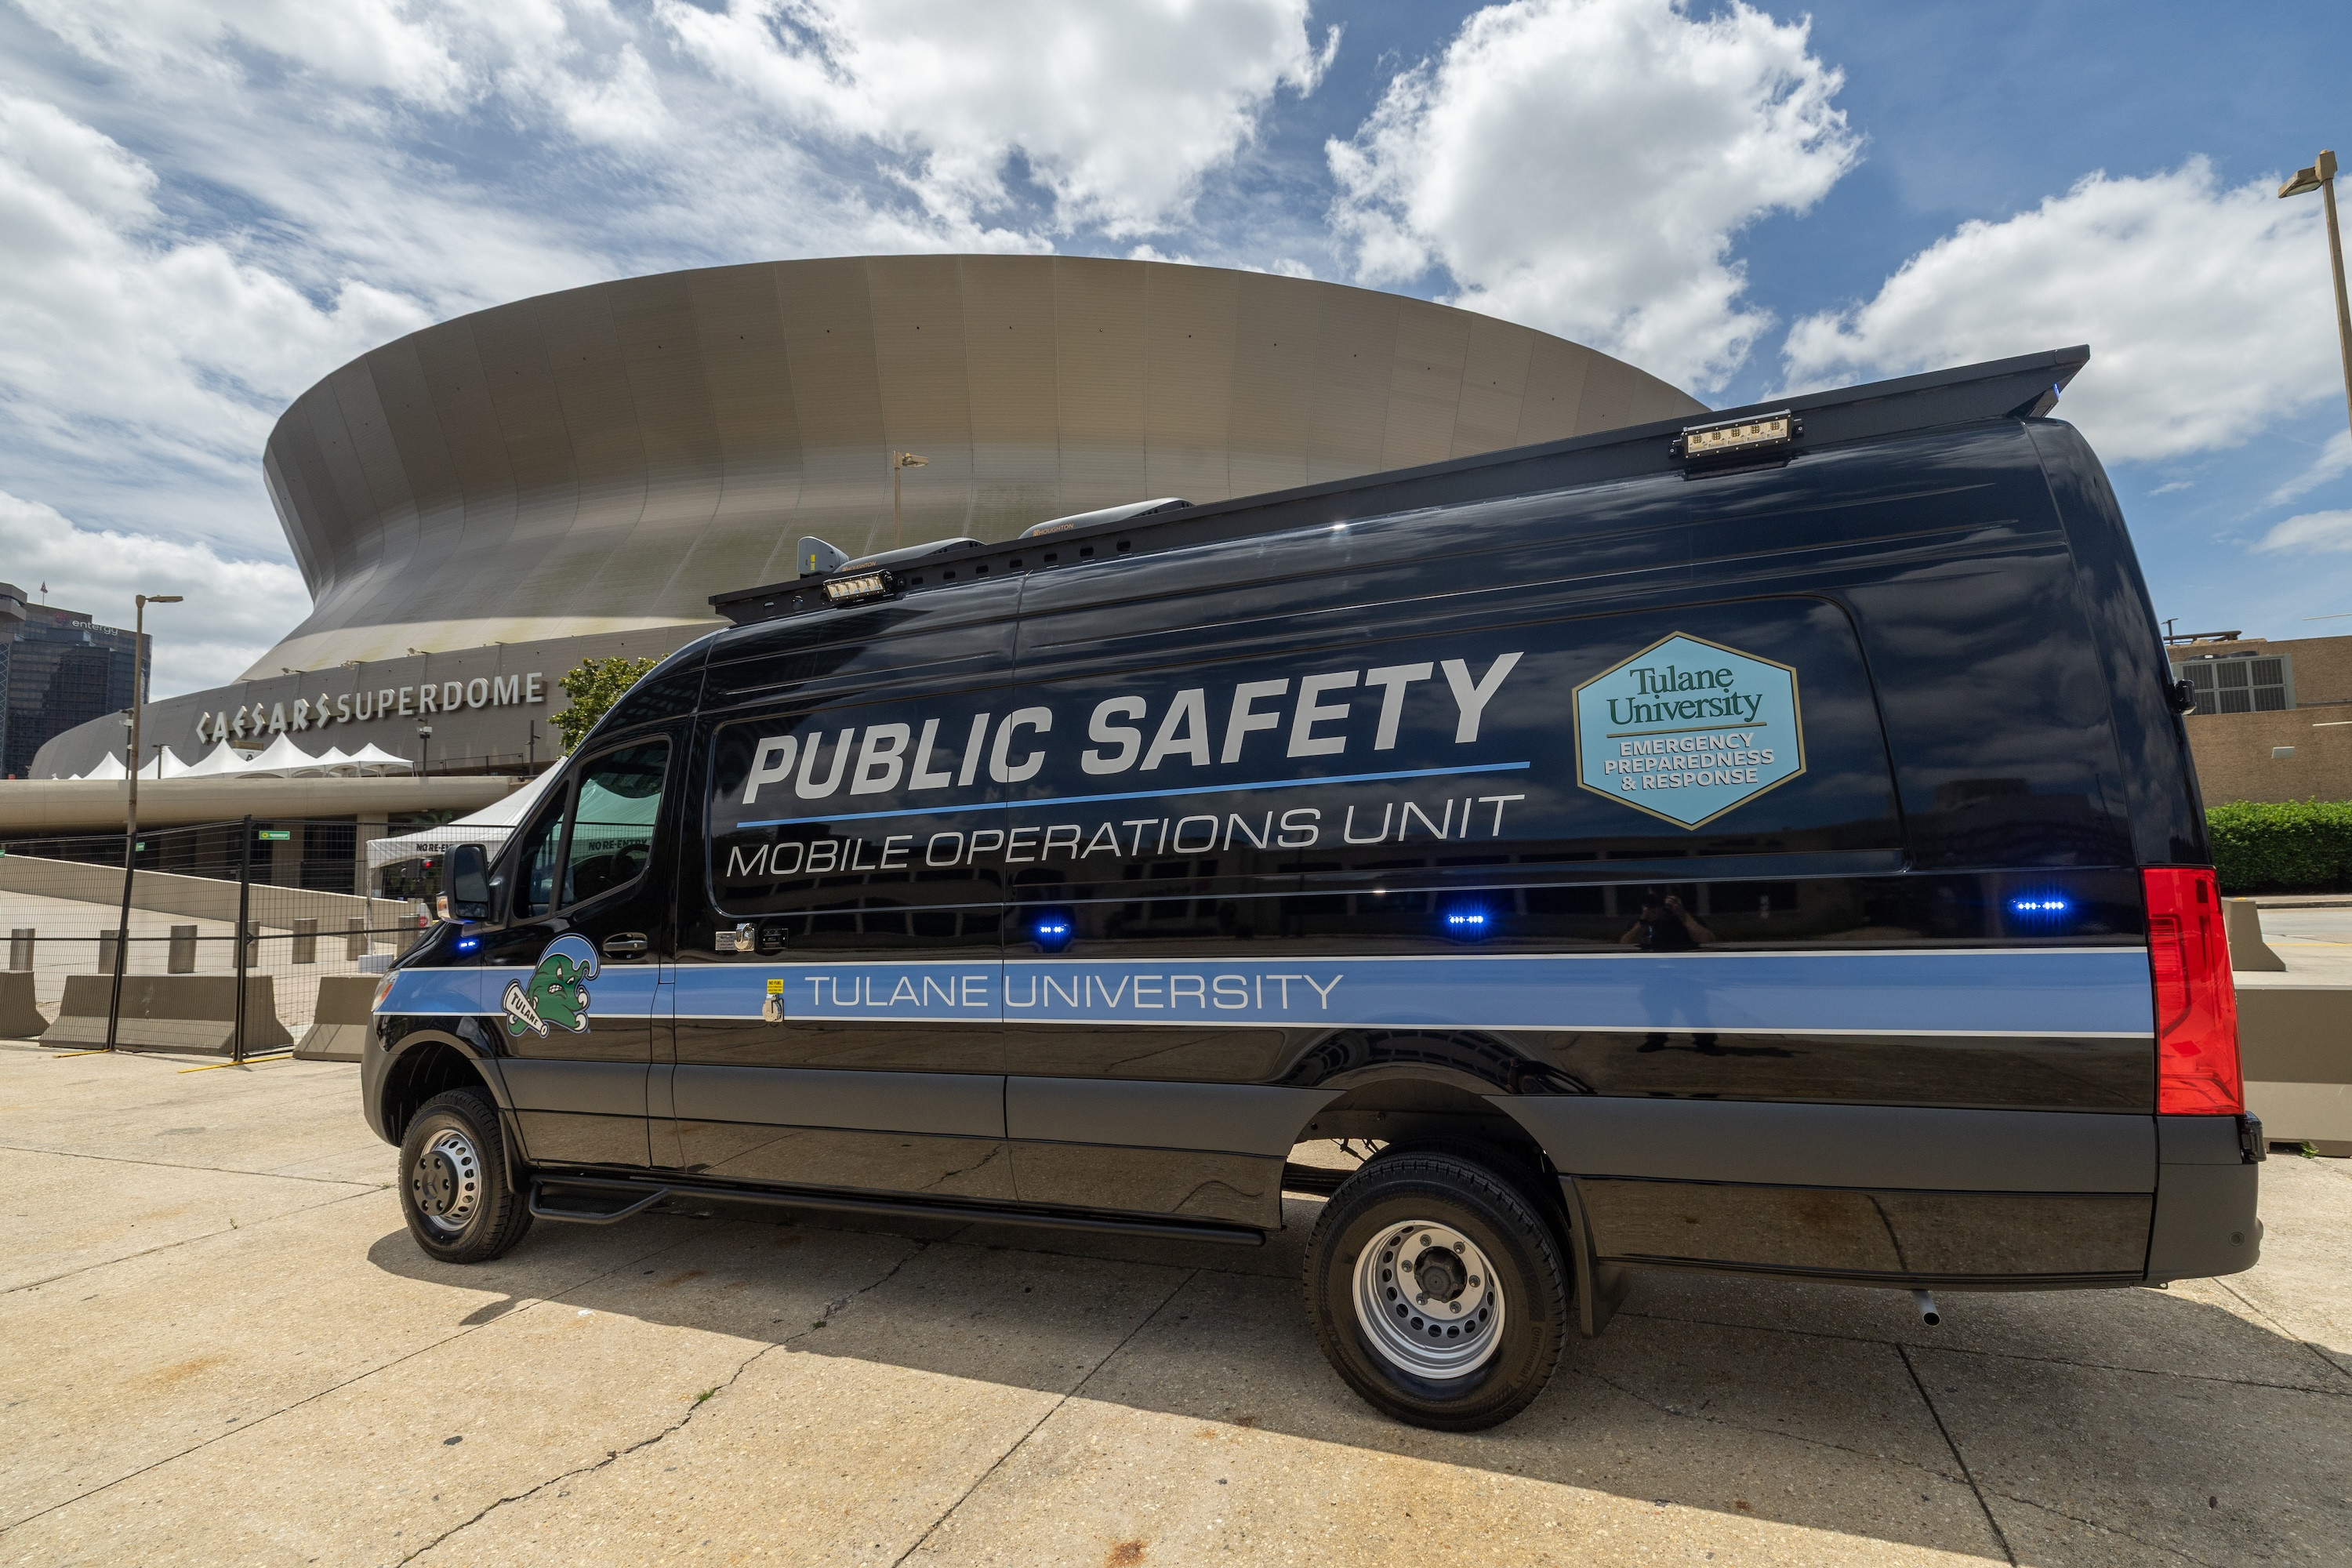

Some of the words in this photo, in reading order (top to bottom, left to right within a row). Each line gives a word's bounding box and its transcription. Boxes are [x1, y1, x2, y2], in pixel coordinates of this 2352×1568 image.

[71, 619, 118, 636] entergy
[1629, 665, 1734, 695] Tulane
[196, 693, 331, 744] CAESARS
[336, 672, 545, 724] SUPERDOME
[1606, 688, 1763, 725] University
[742, 706, 1052, 804] PUBLIC
[1081, 652, 1524, 775] SAFETY
[1620, 732, 1754, 757] EMERGENCY
[1604, 749, 1775, 775] PREPAREDNESS
[1621, 775, 1636, 791] &
[1642, 768, 1759, 789] RESPONSE
[416, 844, 427, 852] NO
[589, 841, 601, 851] NO
[727, 835, 913, 877] MOBILE
[926, 808, 1321, 867] OPERATIONS
[1343, 794, 1525, 844] UNIT
[804, 975, 988, 1007] TULANE
[1005, 975, 1344, 1010] UNIVERSITY
[510, 992, 539, 1025] TULANE
